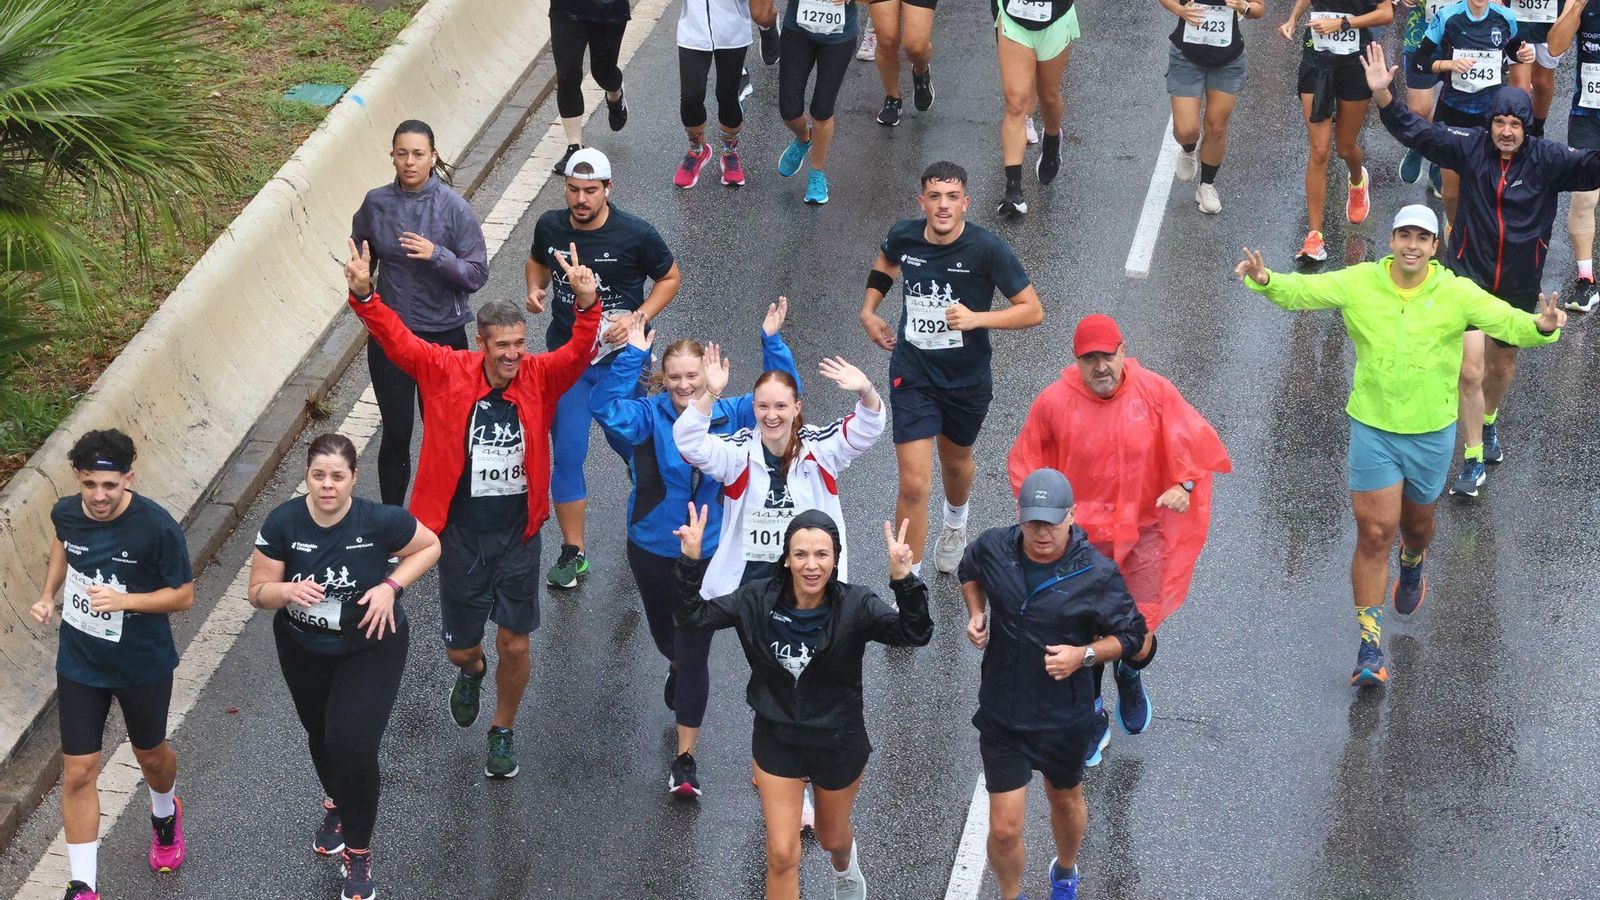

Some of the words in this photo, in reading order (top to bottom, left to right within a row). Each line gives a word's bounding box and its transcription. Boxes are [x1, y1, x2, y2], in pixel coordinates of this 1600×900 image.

[1519, 0, 1549, 9] 5037
[802, 10, 841, 24] 12790
[1461, 69, 1494, 80] 6543
[912, 318, 953, 333] 1292
[750, 530, 780, 545] 101
[291, 609, 329, 628] 6659
